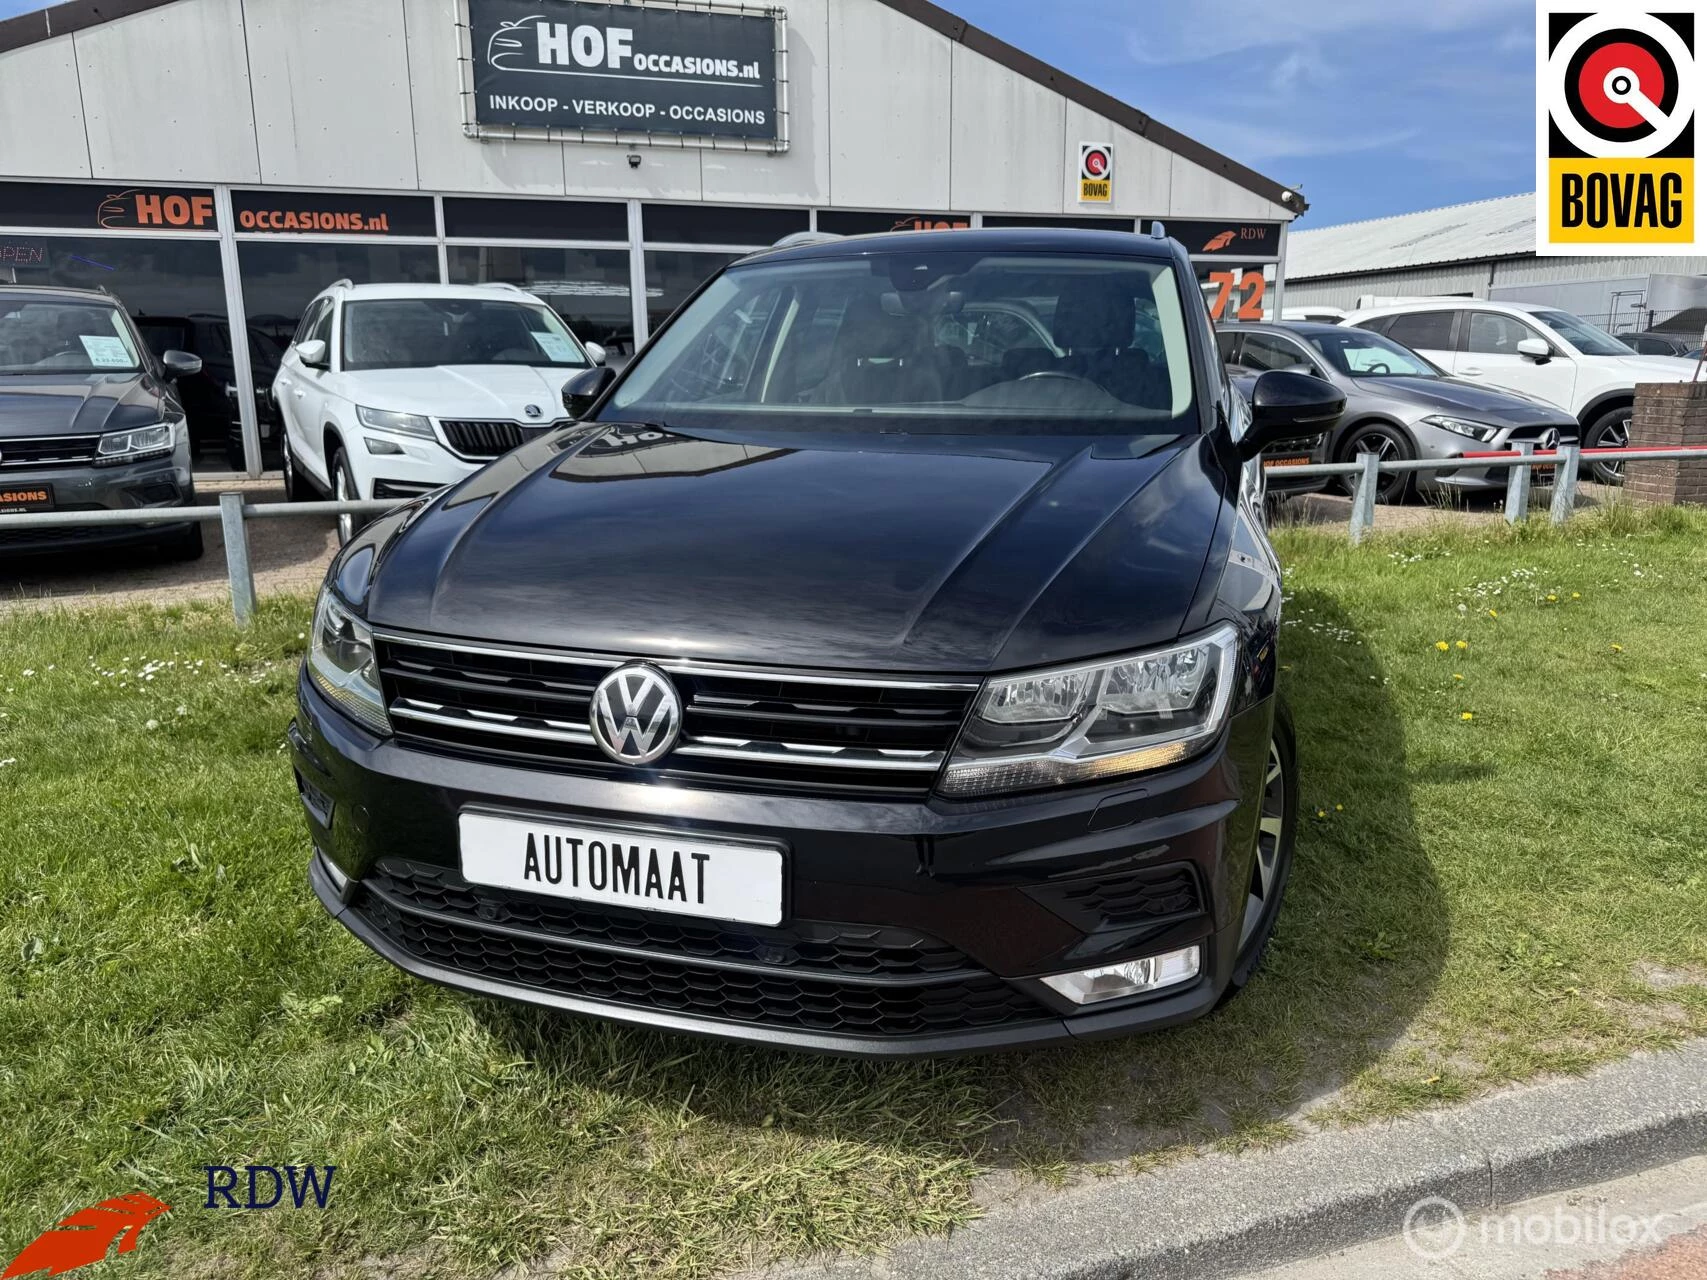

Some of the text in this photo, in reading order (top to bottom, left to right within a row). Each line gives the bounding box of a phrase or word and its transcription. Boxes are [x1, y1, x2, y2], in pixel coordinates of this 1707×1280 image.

[536, 21, 760, 79] HOF OCCASIONS.nl
[489, 95, 558, 112] INKOOP
[572, 100, 656, 118] VERKOOP
[669, 105, 766, 125] OCCASIONS
[1083, 182, 1108, 197] BOVAG
[135, 193, 389, 232] HOF OCCASIONS.nl
[1240, 227, 1266, 240] RDW
[0, 246, 43, 262] PEN
[1209, 271, 1265, 320] 72
[523, 832, 710, 904] AUTOMAAT
